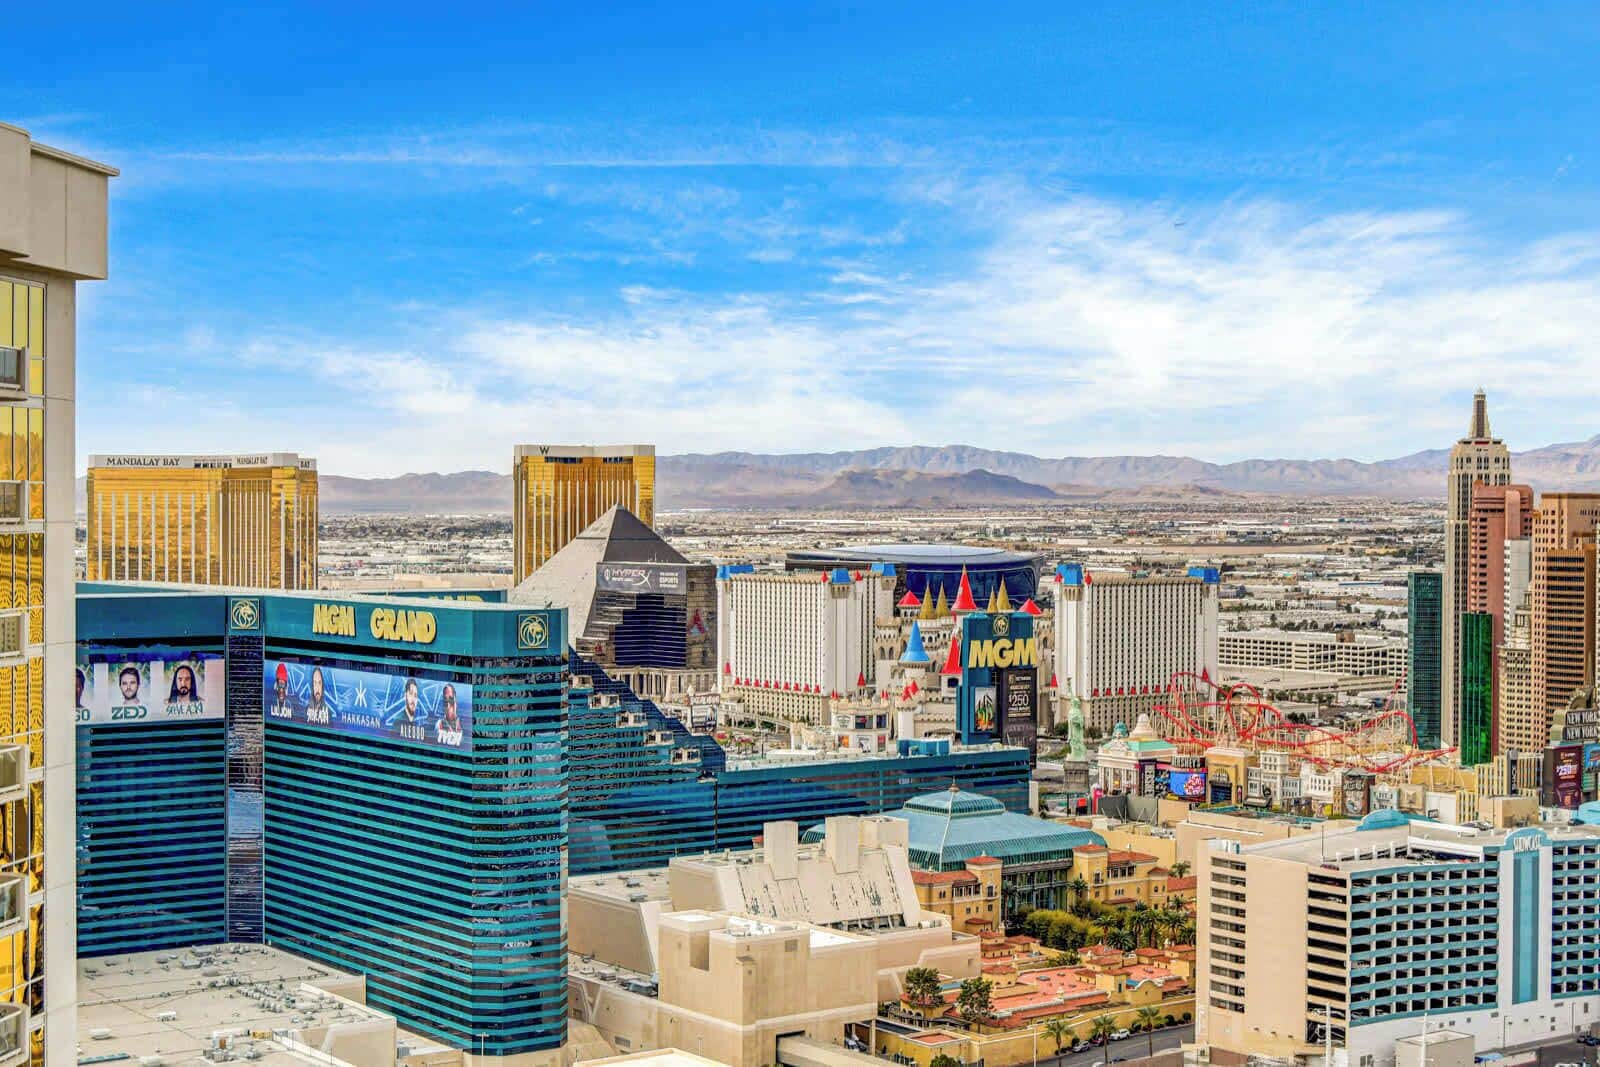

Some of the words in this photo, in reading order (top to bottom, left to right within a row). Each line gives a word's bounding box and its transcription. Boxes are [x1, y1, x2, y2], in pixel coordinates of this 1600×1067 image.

[539, 445, 551, 455] W
[106, 457, 160, 466] MANDALAY
[163, 457, 181, 466] BAY
[312, 603, 356, 637] MGM
[370, 607, 437, 644] GRAND
[968, 638, 1038, 669] MGM
[1007, 694, 1029, 707] $250
[111, 705, 148, 720] ZEDD
[1567, 712, 1581, 724] NEW
[1581, 711, 1598, 723] YORK
[341, 712, 380, 728] HAKKASAN
[1566, 726, 1580, 739] NEW
[1581, 725, 1598, 738] YORK
